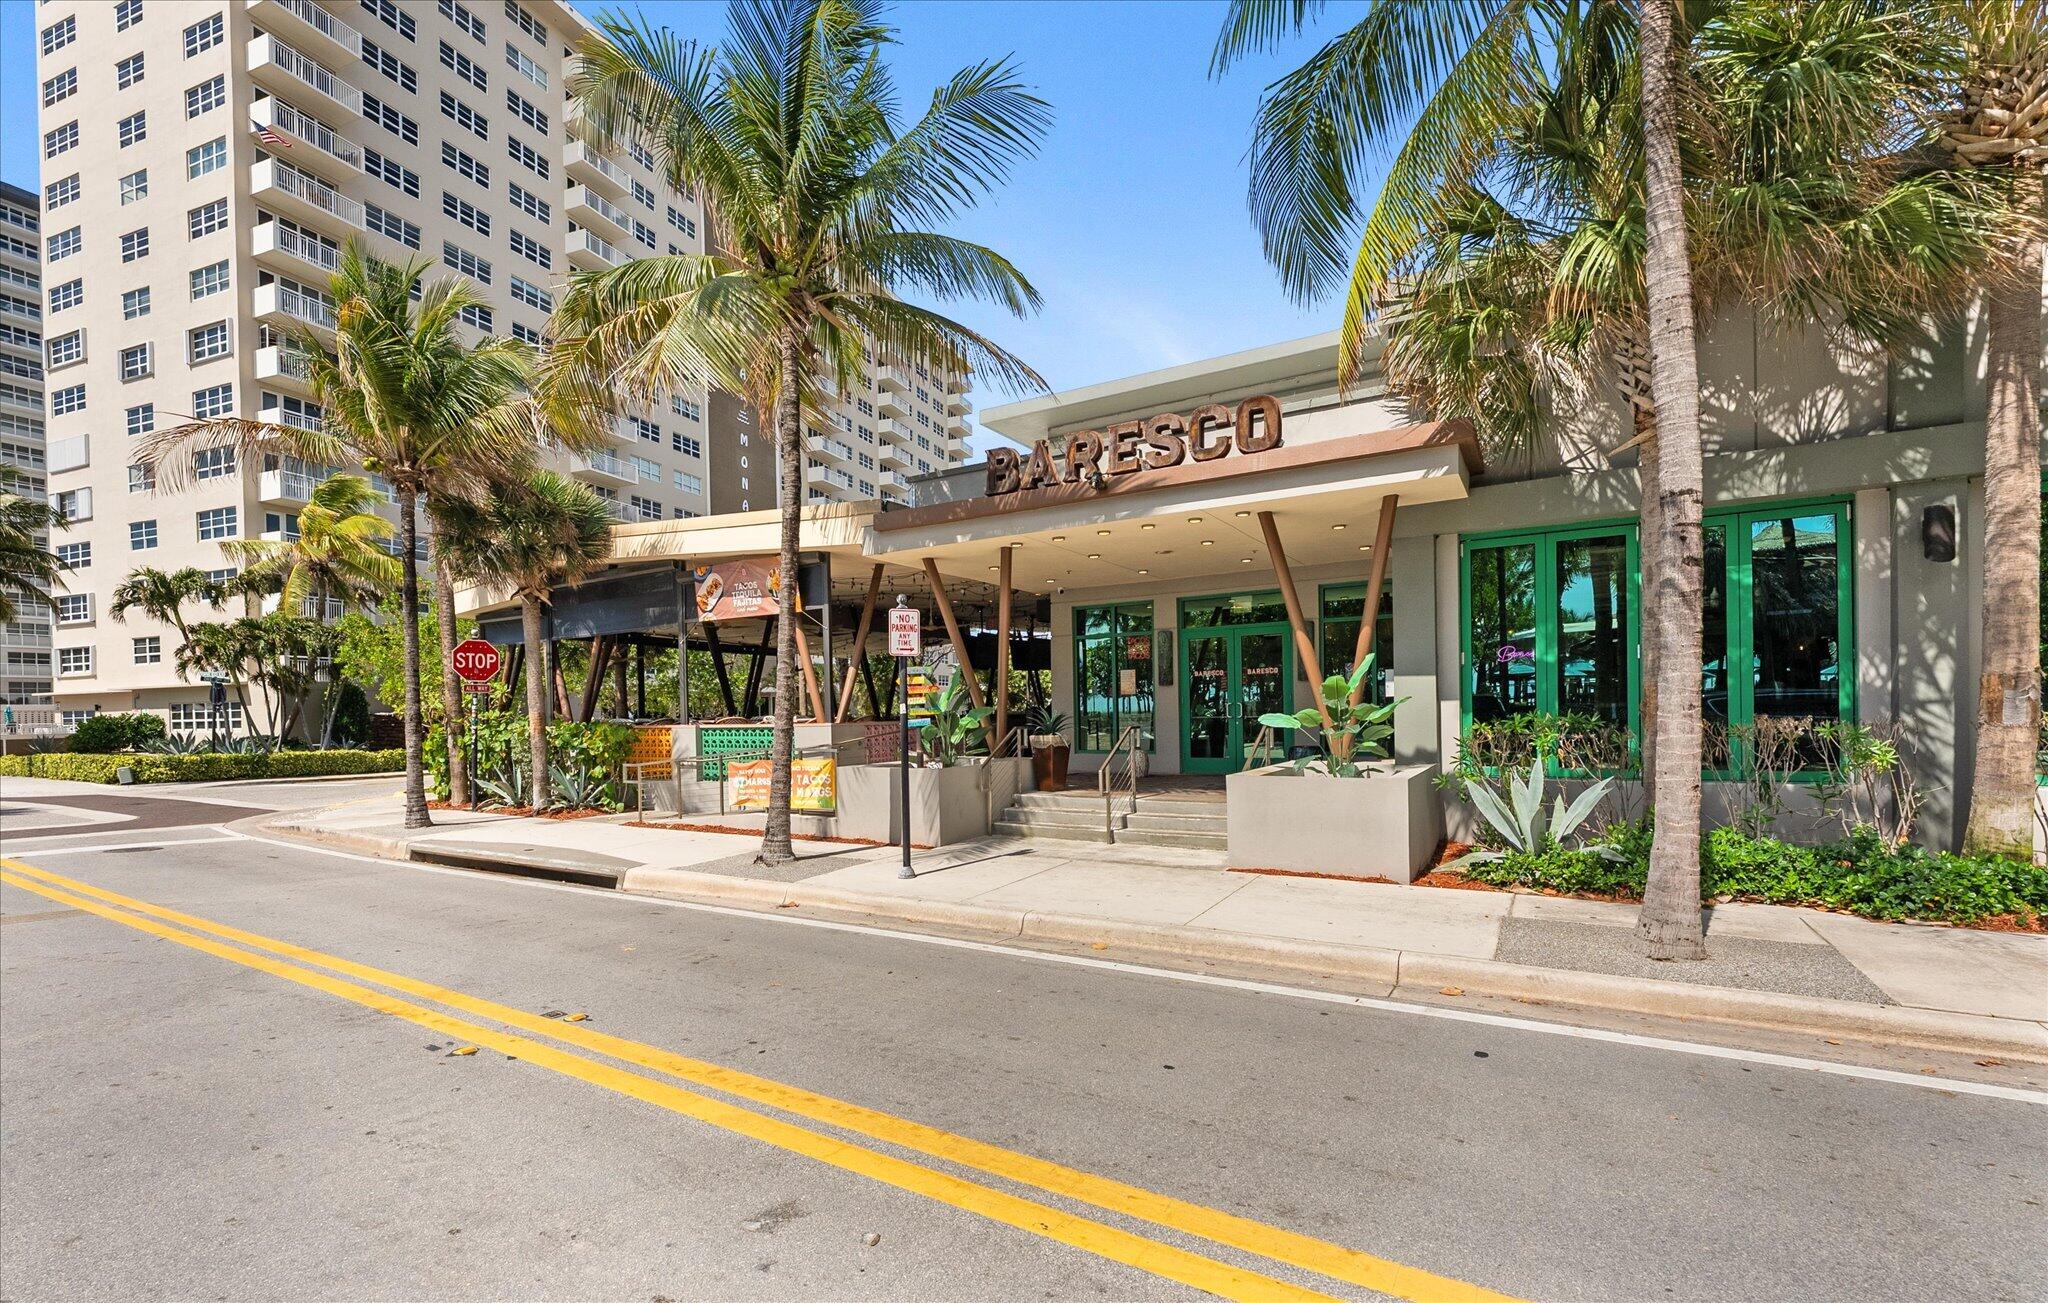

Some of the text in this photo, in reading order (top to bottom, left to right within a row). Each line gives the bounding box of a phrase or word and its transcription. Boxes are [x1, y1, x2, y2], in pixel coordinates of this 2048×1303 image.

[985, 394, 1283, 496] BARESCO
[734, 581, 758, 590] TACOS
[731, 589, 762, 599] TEQUILA
[733, 598, 762, 607] FAJITAS
[898, 614, 911, 623] NO
[891, 623, 918, 633] PARKING
[455, 652, 497, 669] STOP
[1194, 669, 1224, 677] BARESCO
[1246, 667, 1279, 675] BARESCO
[746, 777, 771, 786] MARGS
[796, 774, 831, 785] TACOS
